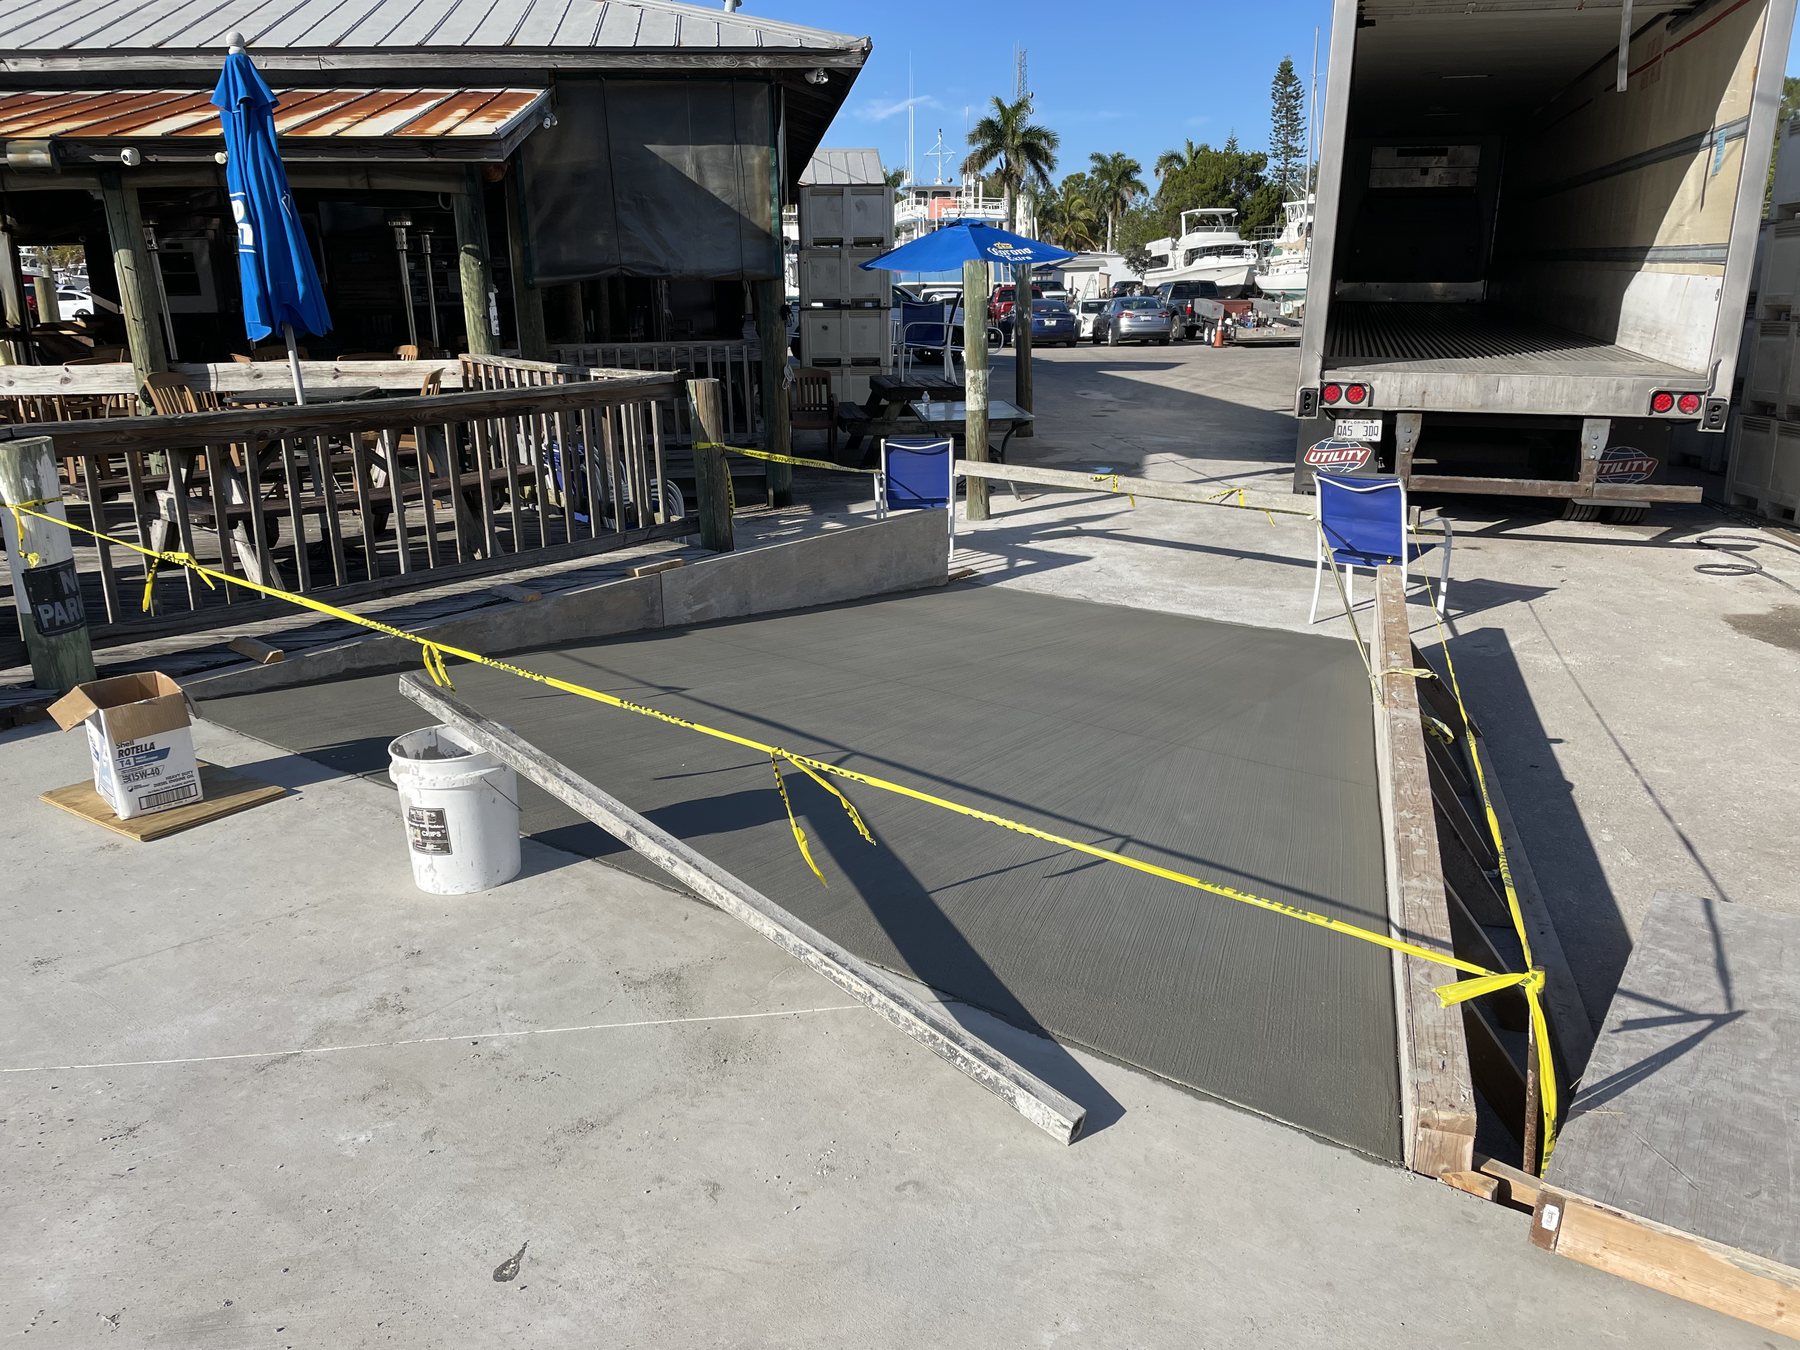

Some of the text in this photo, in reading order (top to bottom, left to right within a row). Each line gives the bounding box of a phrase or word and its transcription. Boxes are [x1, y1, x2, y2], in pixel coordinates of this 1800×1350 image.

[987, 246, 1032, 258] Corona
[1309, 450, 1366, 462] UTILITY
[1598, 460, 1652, 474] TILITY
[115, 739, 134, 749] Shell
[117, 741, 156, 758] ROTELLA
[120, 759, 131, 767] T4
[131, 766, 160, 781] 15W-40
